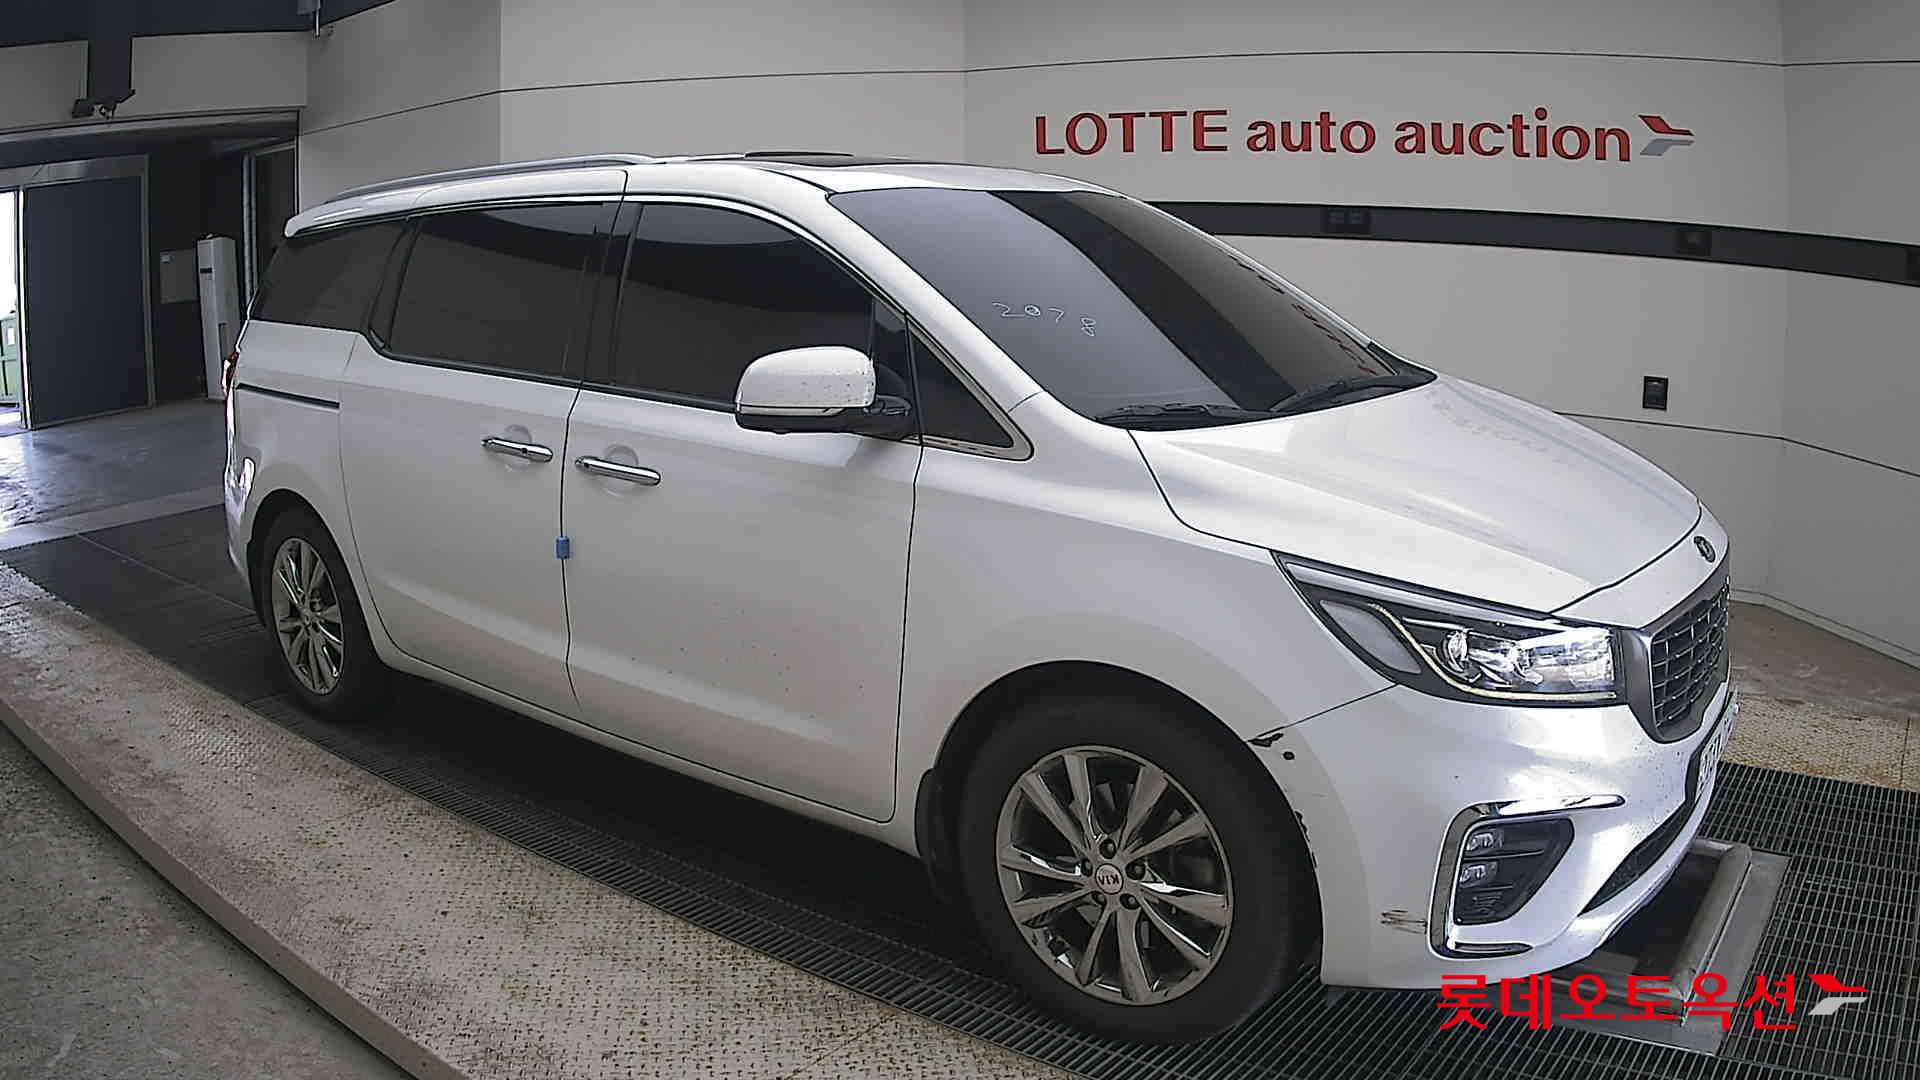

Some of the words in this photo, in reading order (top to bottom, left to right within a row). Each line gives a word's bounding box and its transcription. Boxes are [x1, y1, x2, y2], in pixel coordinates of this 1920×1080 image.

[1035, 110, 1228, 154] LOTTE
[1246, 111, 1376, 154] auto
[1394, 108, 1631, 162] auction
[991, 302, 1097, 337] 2078
[1097, 874, 1120, 886] KIA
